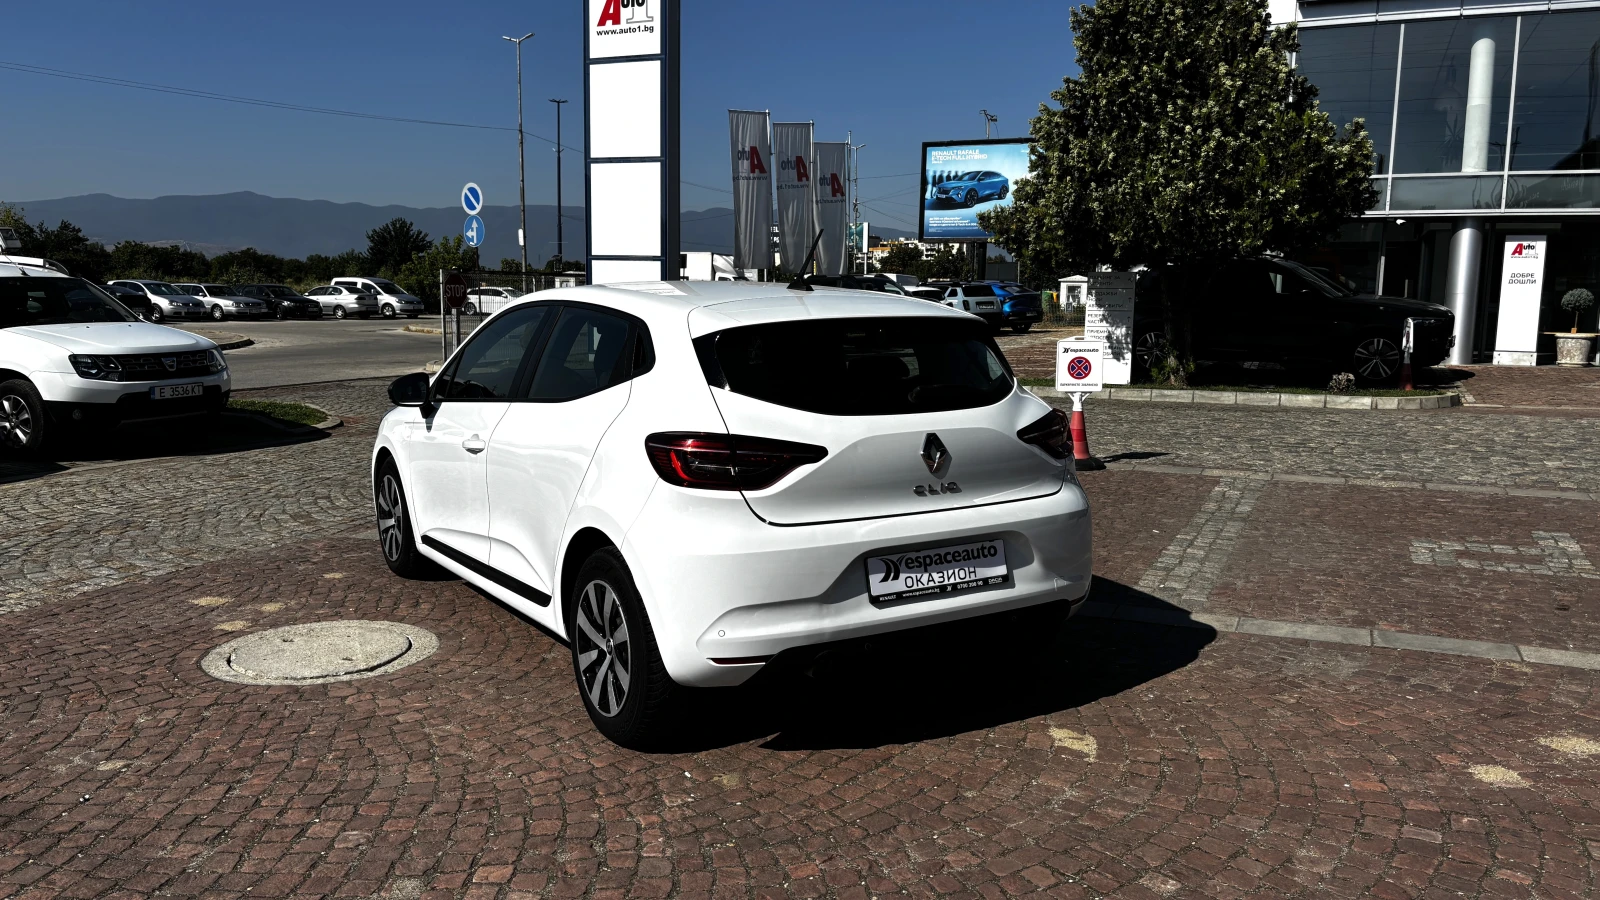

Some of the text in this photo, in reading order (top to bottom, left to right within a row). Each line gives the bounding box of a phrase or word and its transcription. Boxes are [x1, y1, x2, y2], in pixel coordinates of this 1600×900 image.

[596, 25, 654, 36] www.auto1.bg
[446, 285, 464, 296] STOP
[160, 388, 165, 397] E
[170, 386, 190, 396] 3536
[913, 482, 962, 497] CLIO
[904, 544, 998, 572] espaceauto
[904, 566, 977, 588] ОКАЗИОН
